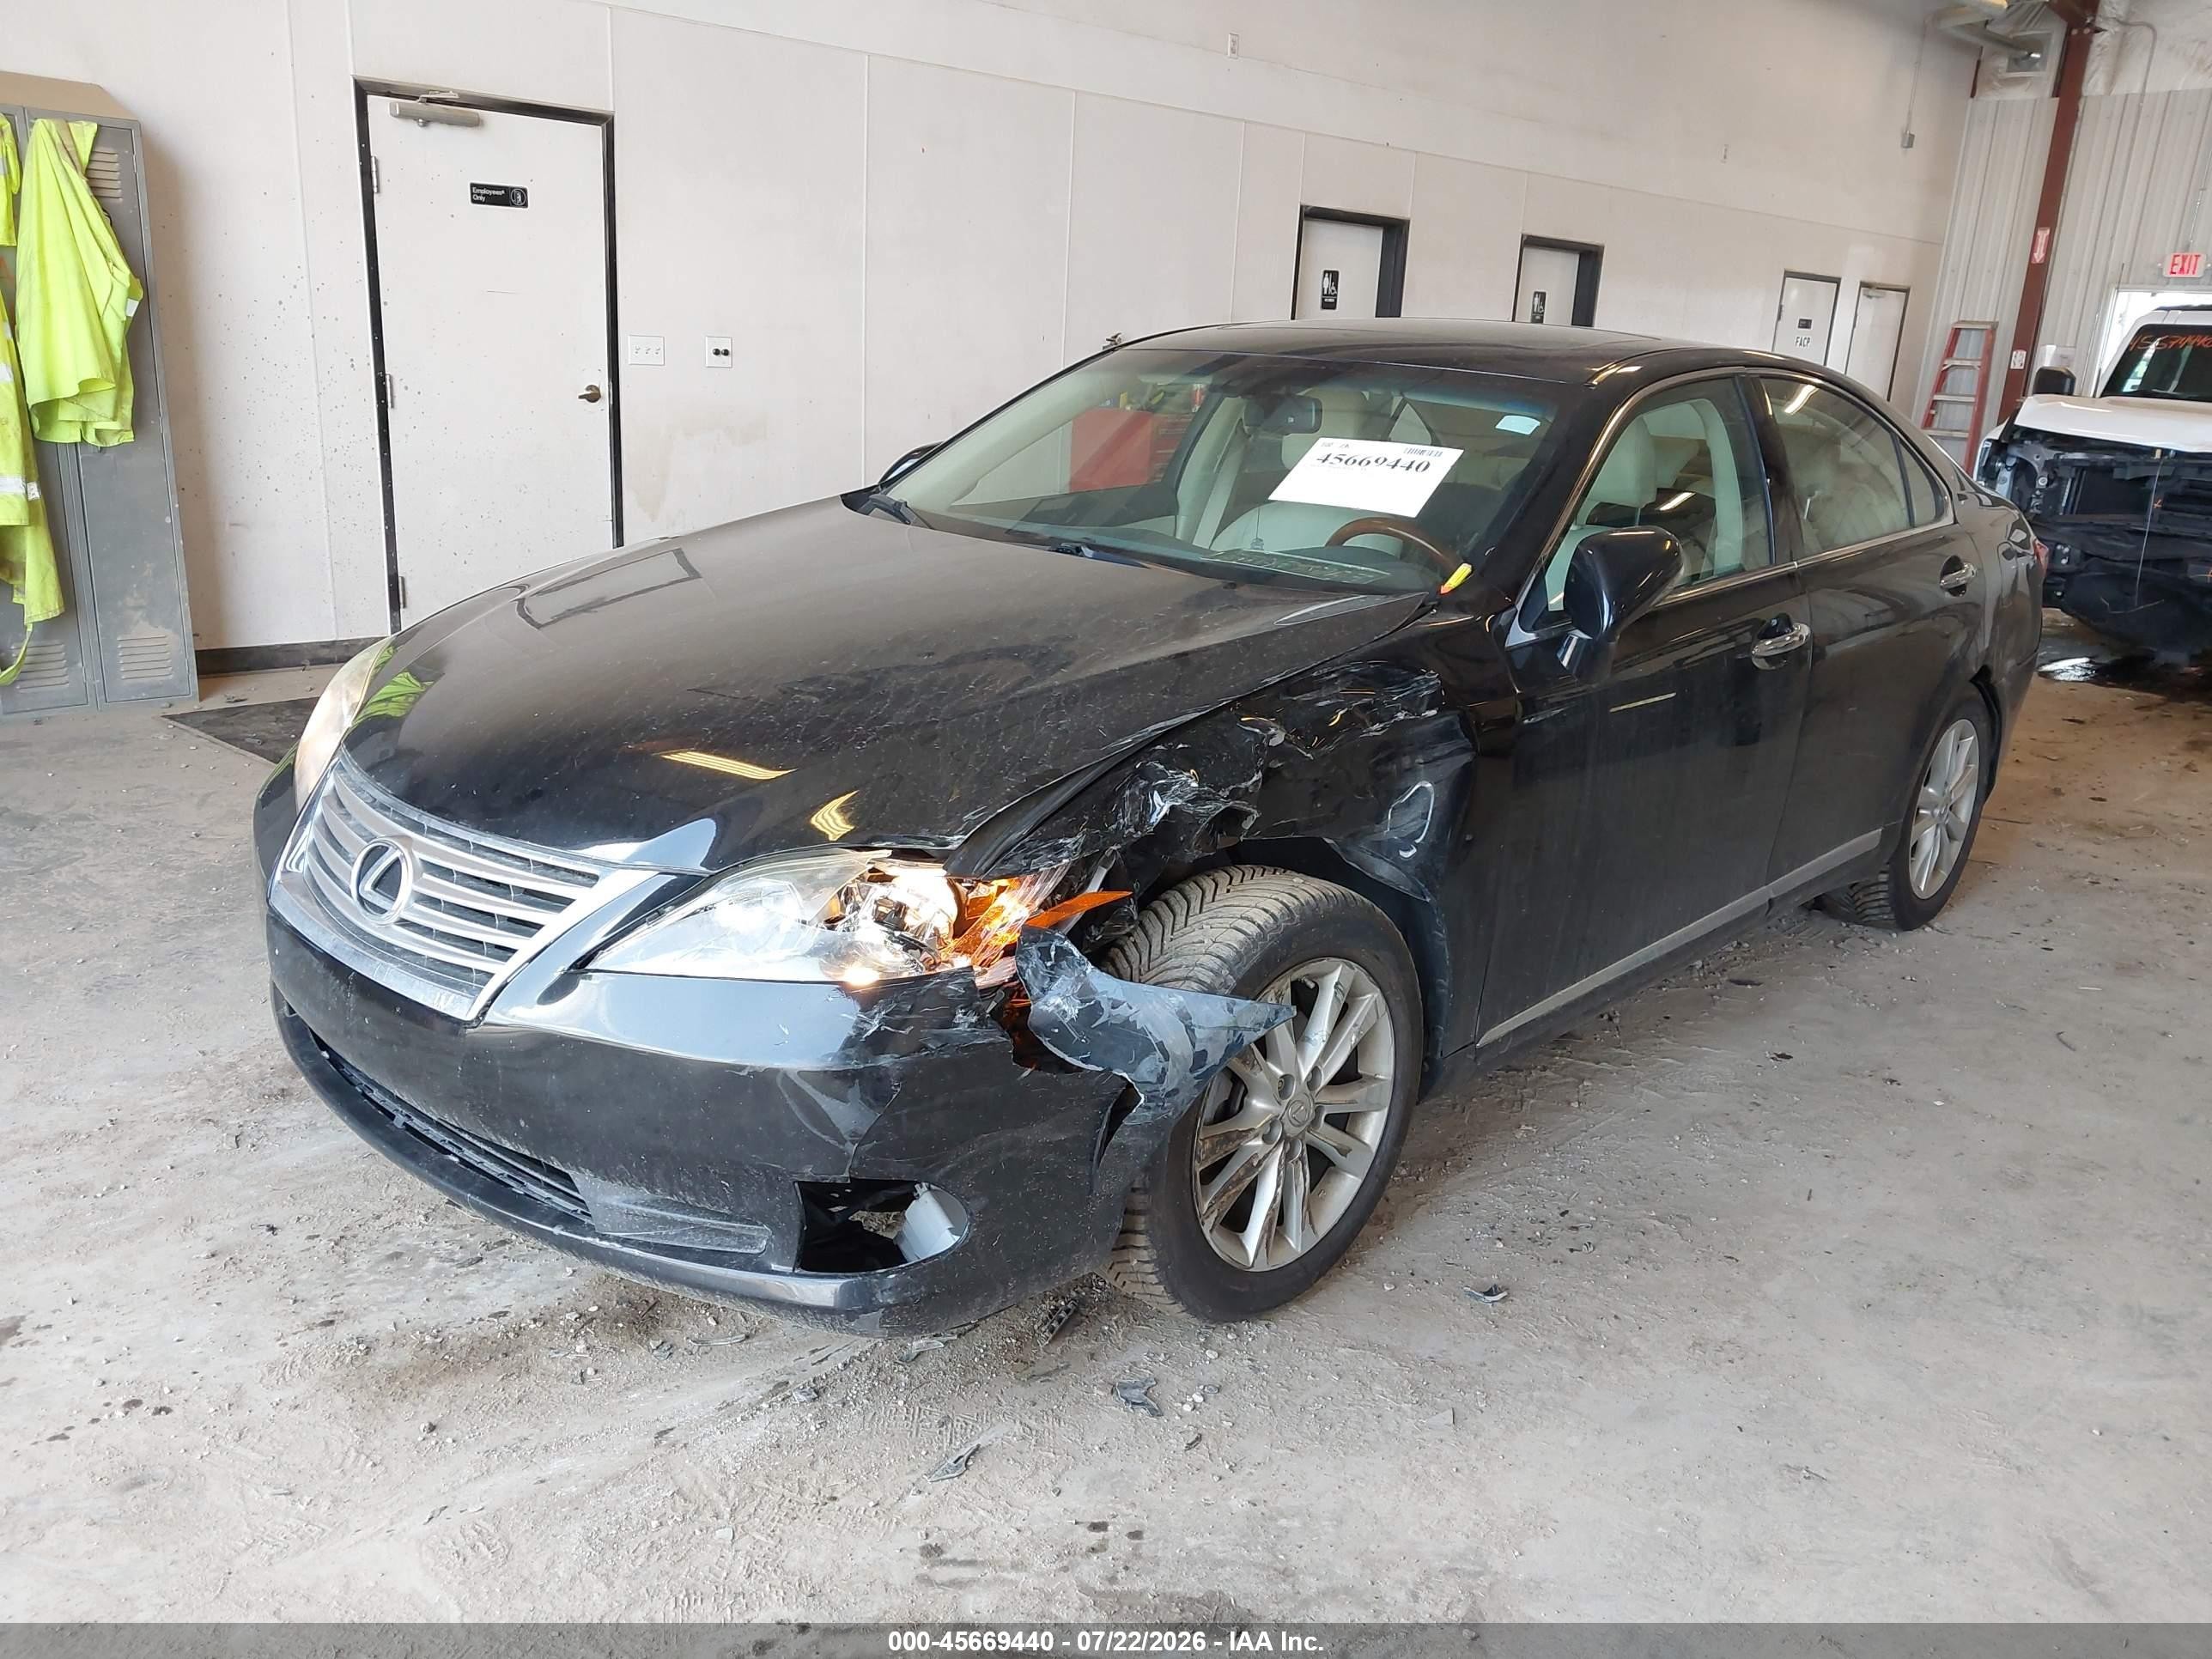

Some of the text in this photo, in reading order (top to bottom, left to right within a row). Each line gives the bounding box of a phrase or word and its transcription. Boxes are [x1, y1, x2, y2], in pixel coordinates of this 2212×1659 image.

[472, 193, 486, 203] Only
[2170, 254, 2201, 275] EXIT
[1796, 336, 1811, 348] FACP
[1316, 453, 1431, 473] 45669440
